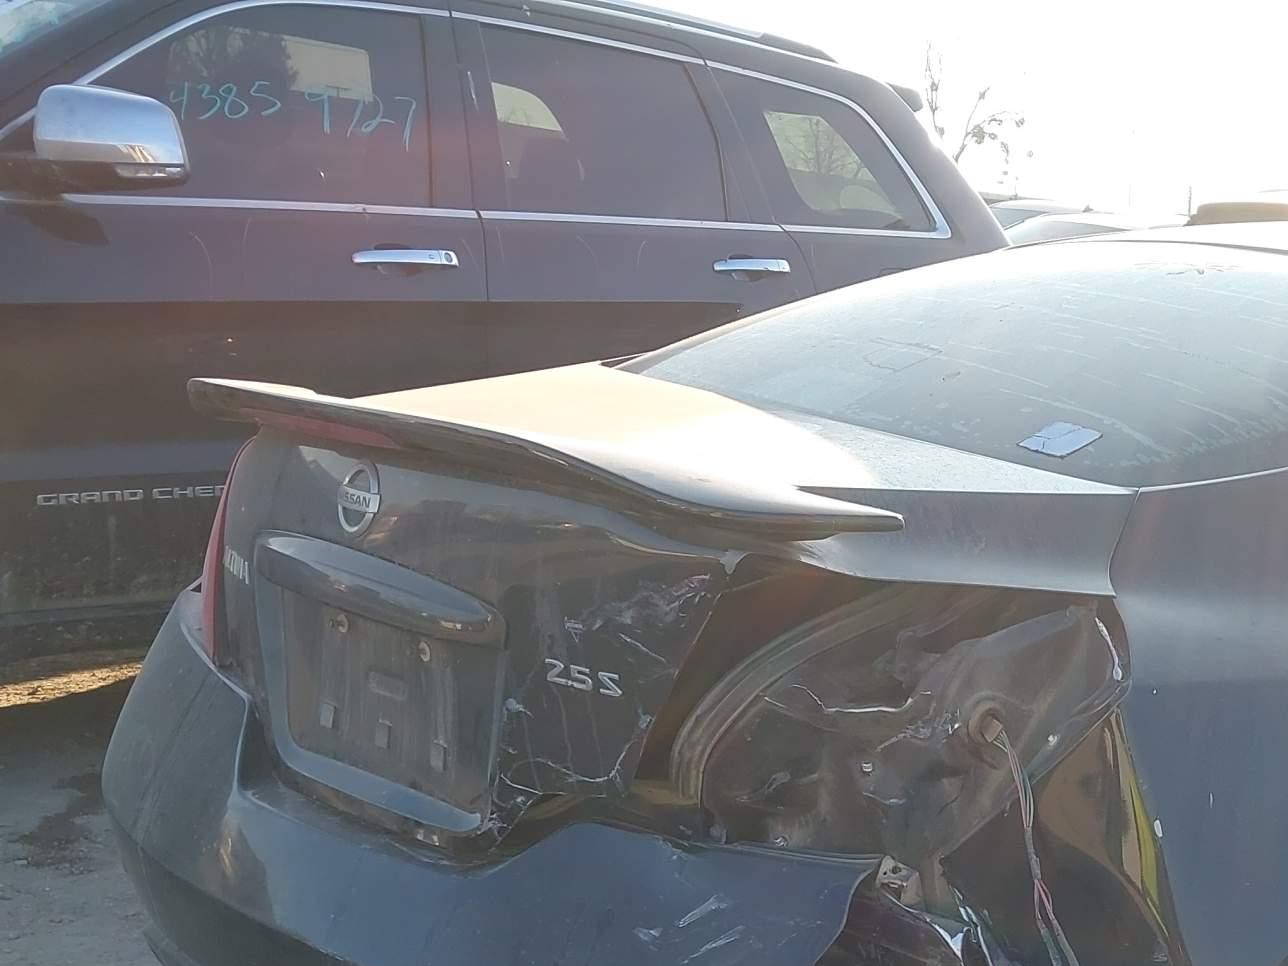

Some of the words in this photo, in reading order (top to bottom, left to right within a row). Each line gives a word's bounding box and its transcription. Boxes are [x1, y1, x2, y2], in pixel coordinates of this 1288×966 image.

[169, 80, 282, 120] 4385
[304, 89, 417, 152] 9727
[36, 489, 144, 506] GRAND
[598, 671, 622, 697] S
